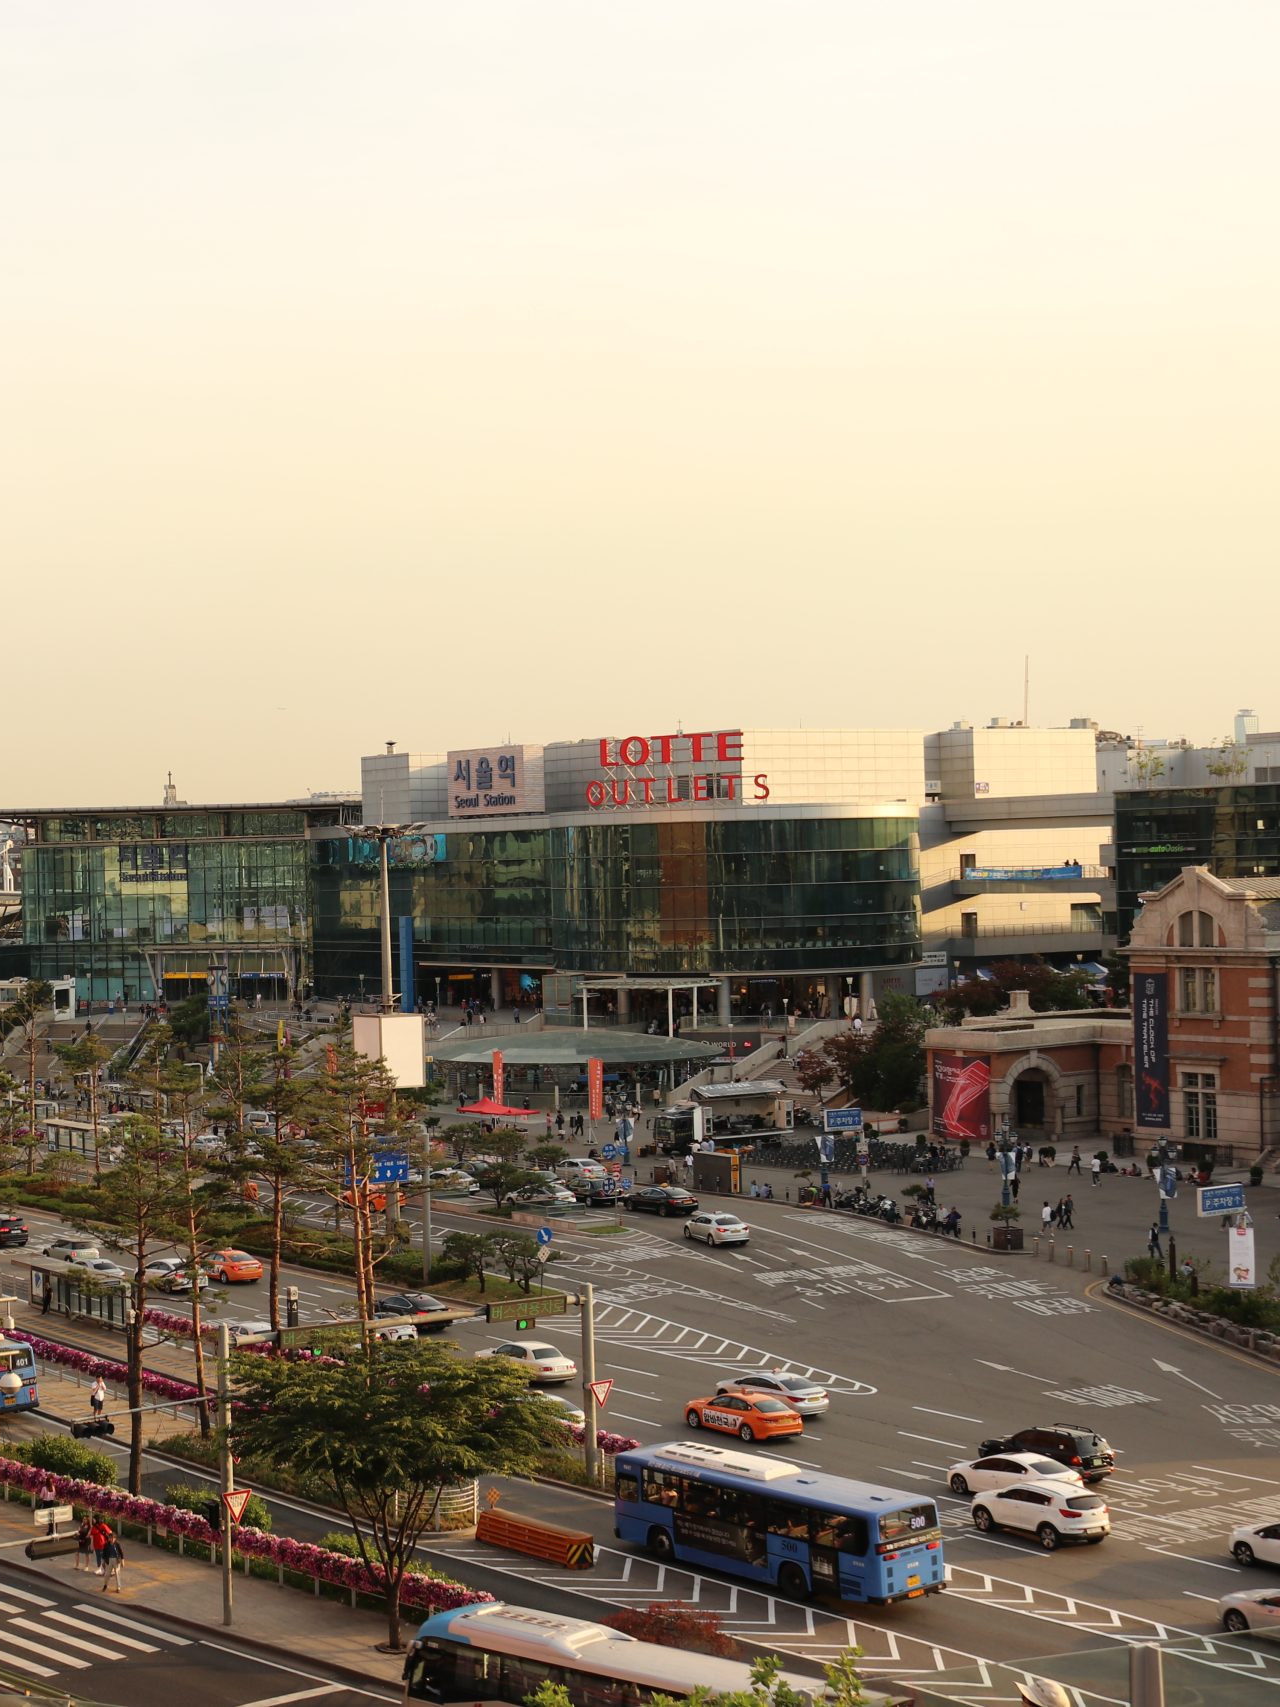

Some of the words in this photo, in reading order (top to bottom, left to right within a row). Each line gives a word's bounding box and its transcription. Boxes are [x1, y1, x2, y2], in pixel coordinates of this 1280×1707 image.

[599, 731, 744, 767] LOTTE
[453, 754, 516, 790] 서울역
[585, 773, 770, 807] OUTLETS
[454, 793, 480, 809] Seoul
[483, 792, 516, 807] Station
[1148, 1019, 1156, 1049] CLOCK
[711, 1040, 737, 1049] WORLD
[1213, 1196, 1234, 1207] 주차장
[933, 1266, 1016, 1283] 서울역
[956, 1279, 1069, 1300] 롯데마트
[491, 1301, 566, 1320] 버스전용차로
[15, 1358, 29, 1366] 401
[910, 1516, 926, 1529] 500
[781, 1539, 798, 1554] 500
